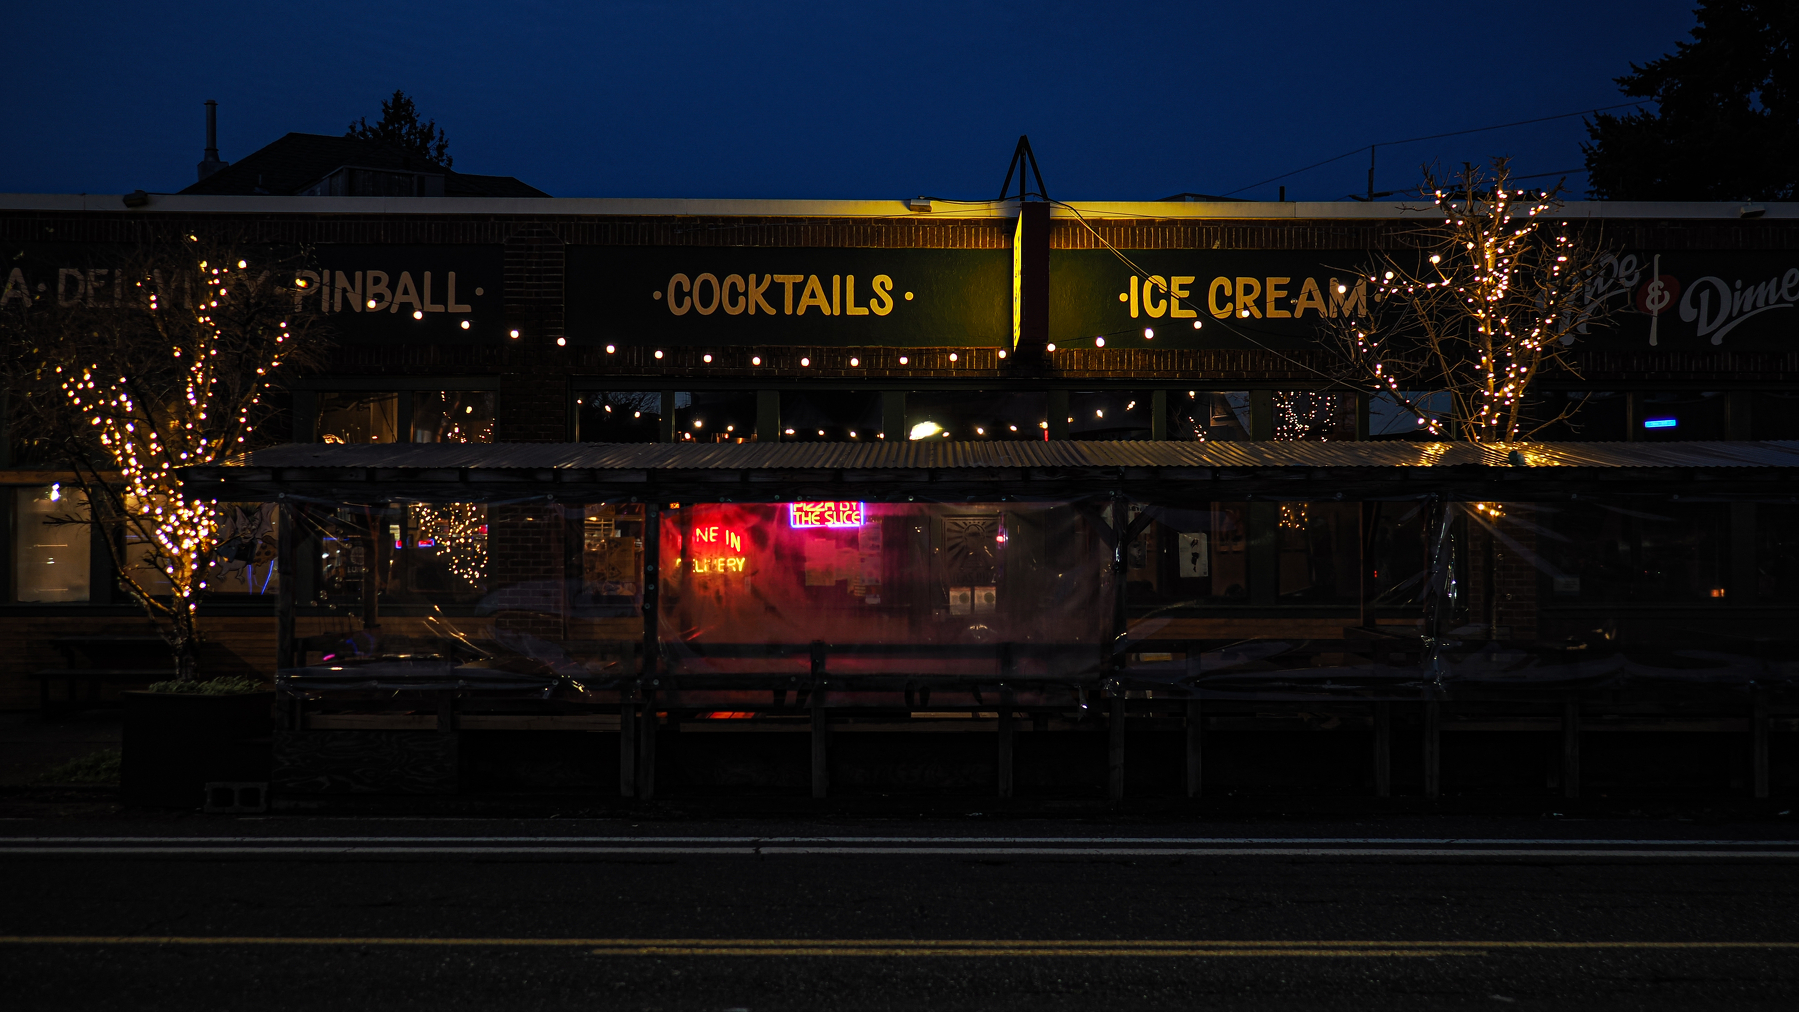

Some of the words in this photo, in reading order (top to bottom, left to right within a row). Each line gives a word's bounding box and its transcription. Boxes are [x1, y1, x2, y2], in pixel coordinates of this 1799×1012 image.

[57, 267, 271, 310] DELVY
[293, 268, 473, 314] PINBALL
[666, 272, 895, 317] COCKTAILS
[1129, 274, 1198, 319] ICE
[1207, 275, 1368, 320] CREAM
[1679, 267, 1799, 340] Dime
[793, 502, 835, 512] PIZZA
[793, 511, 821, 525] THE
[824, 511, 861, 525] SLICE
[725, 529, 741, 552] IN
[677, 557, 745, 573] LIERY
